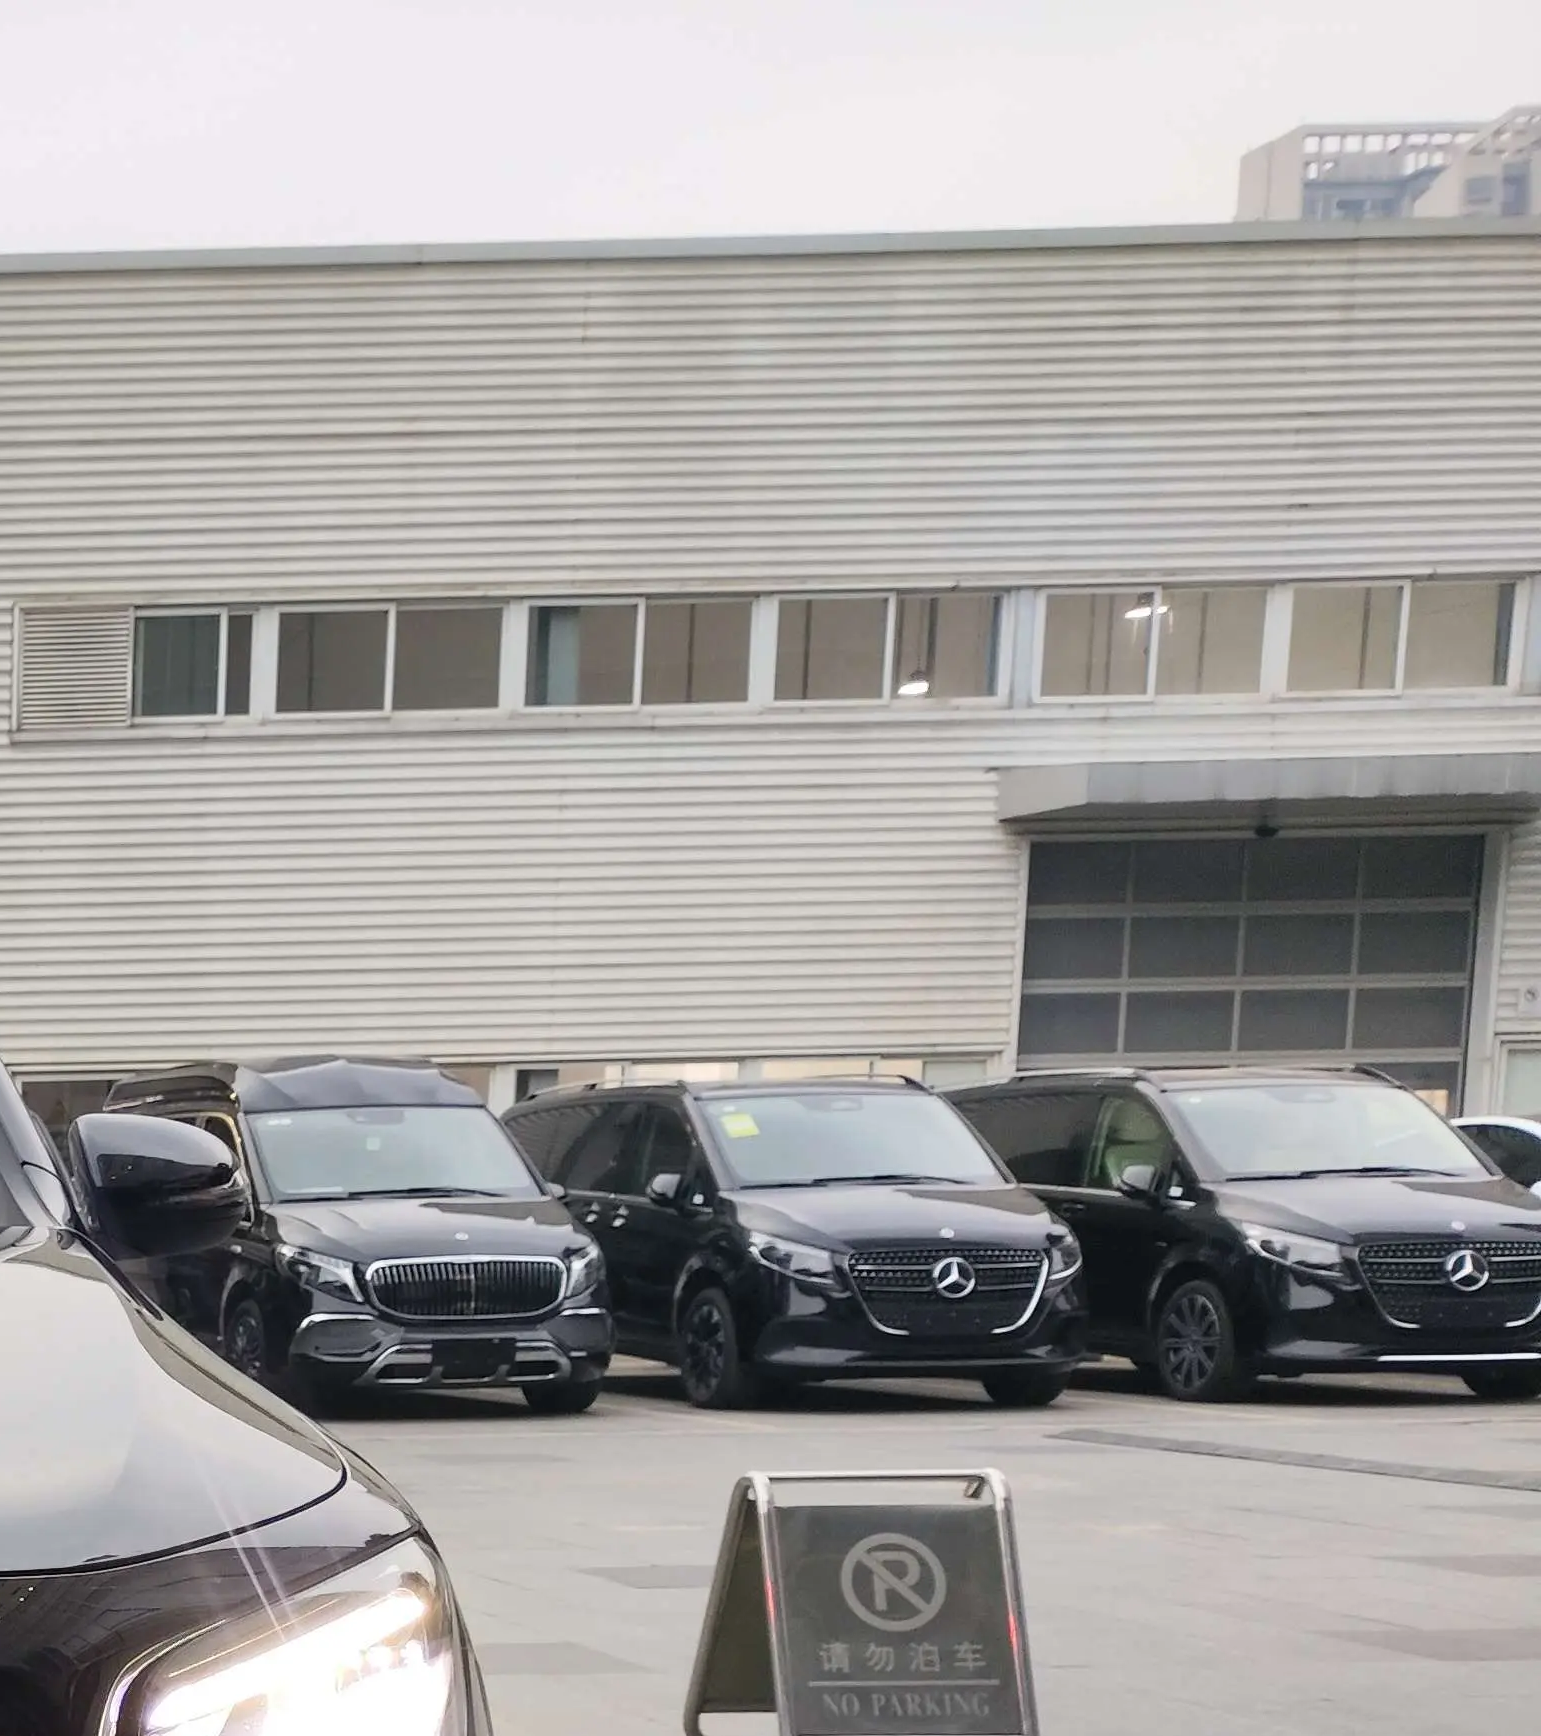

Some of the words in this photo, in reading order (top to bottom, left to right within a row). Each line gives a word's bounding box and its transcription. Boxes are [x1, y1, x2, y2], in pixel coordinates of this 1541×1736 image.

[819, 1641, 987, 1673] 请勿泊车
[822, 1692, 861, 1717] NO
[870, 1692, 990, 1717] PARKING
